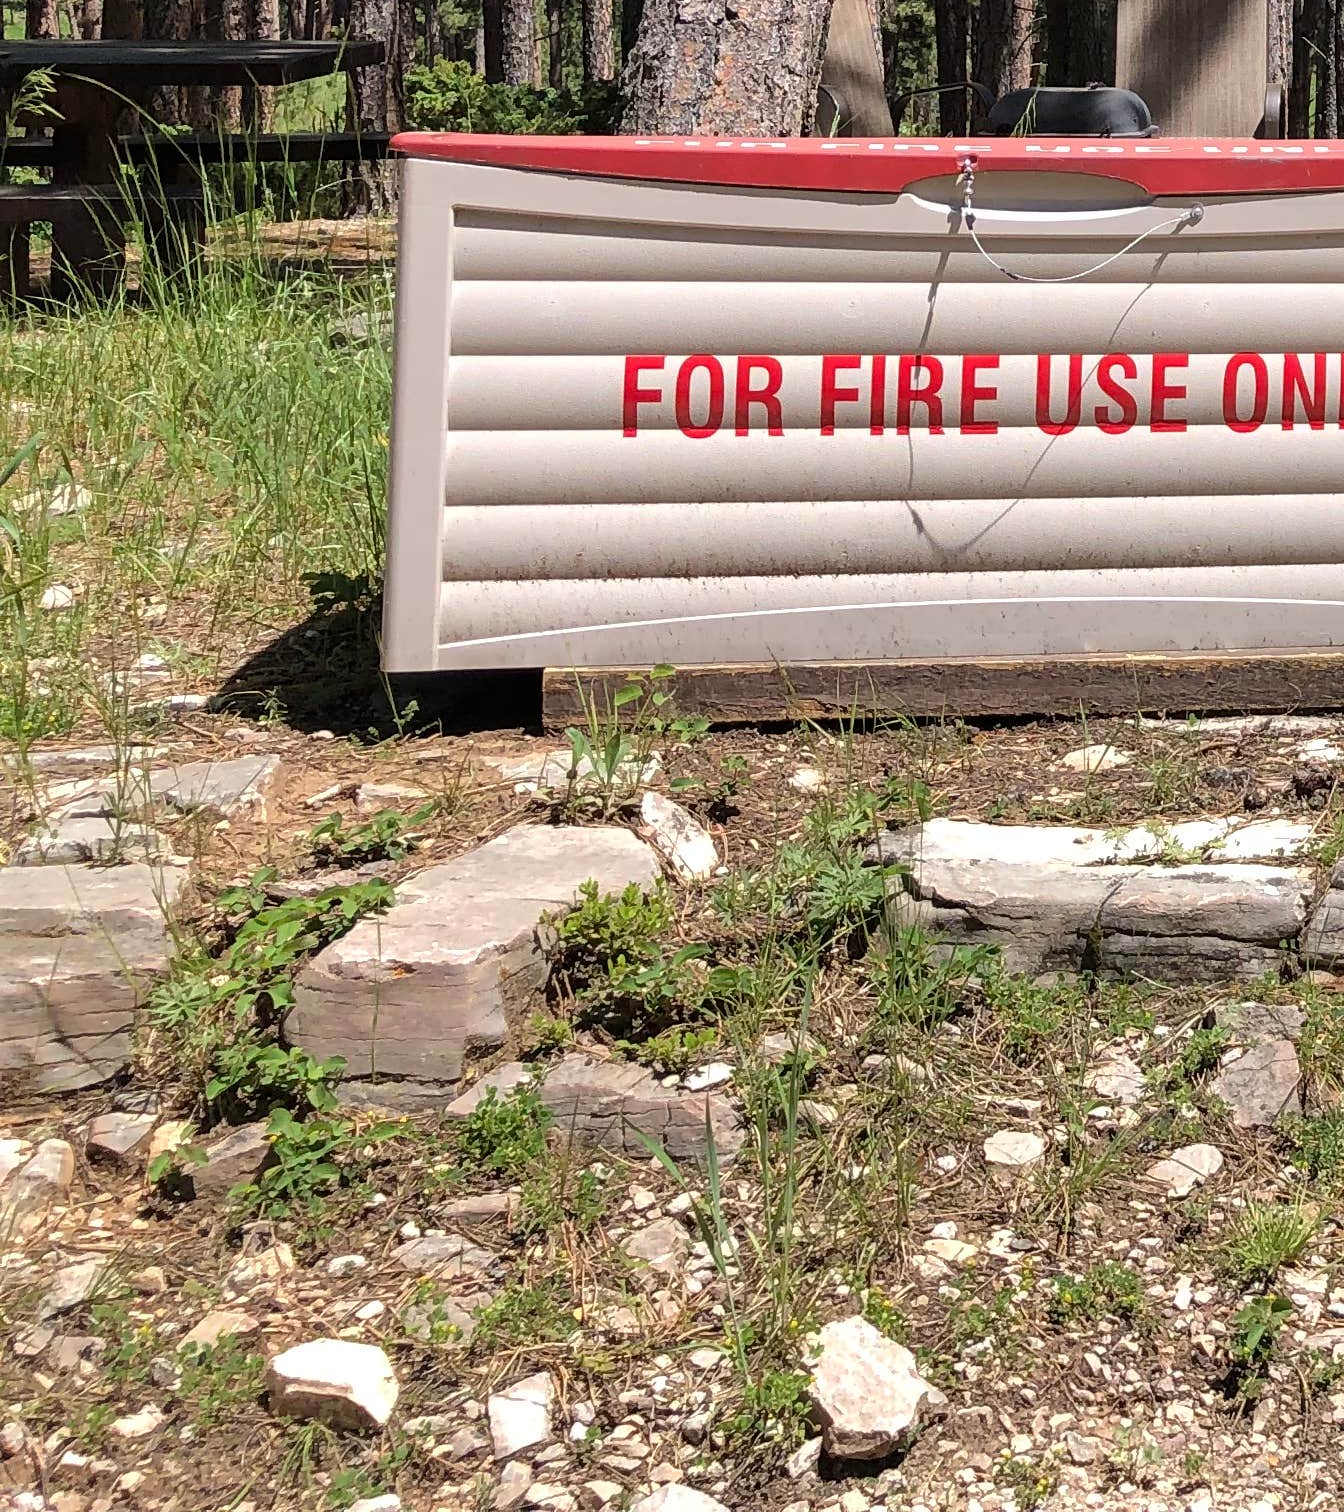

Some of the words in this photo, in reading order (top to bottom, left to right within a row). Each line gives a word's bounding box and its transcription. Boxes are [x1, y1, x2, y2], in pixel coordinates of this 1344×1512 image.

[622, 354, 785, 439] FOR
[820, 354, 1000, 436] FIRE
[1035, 352, 1189, 436] USE
